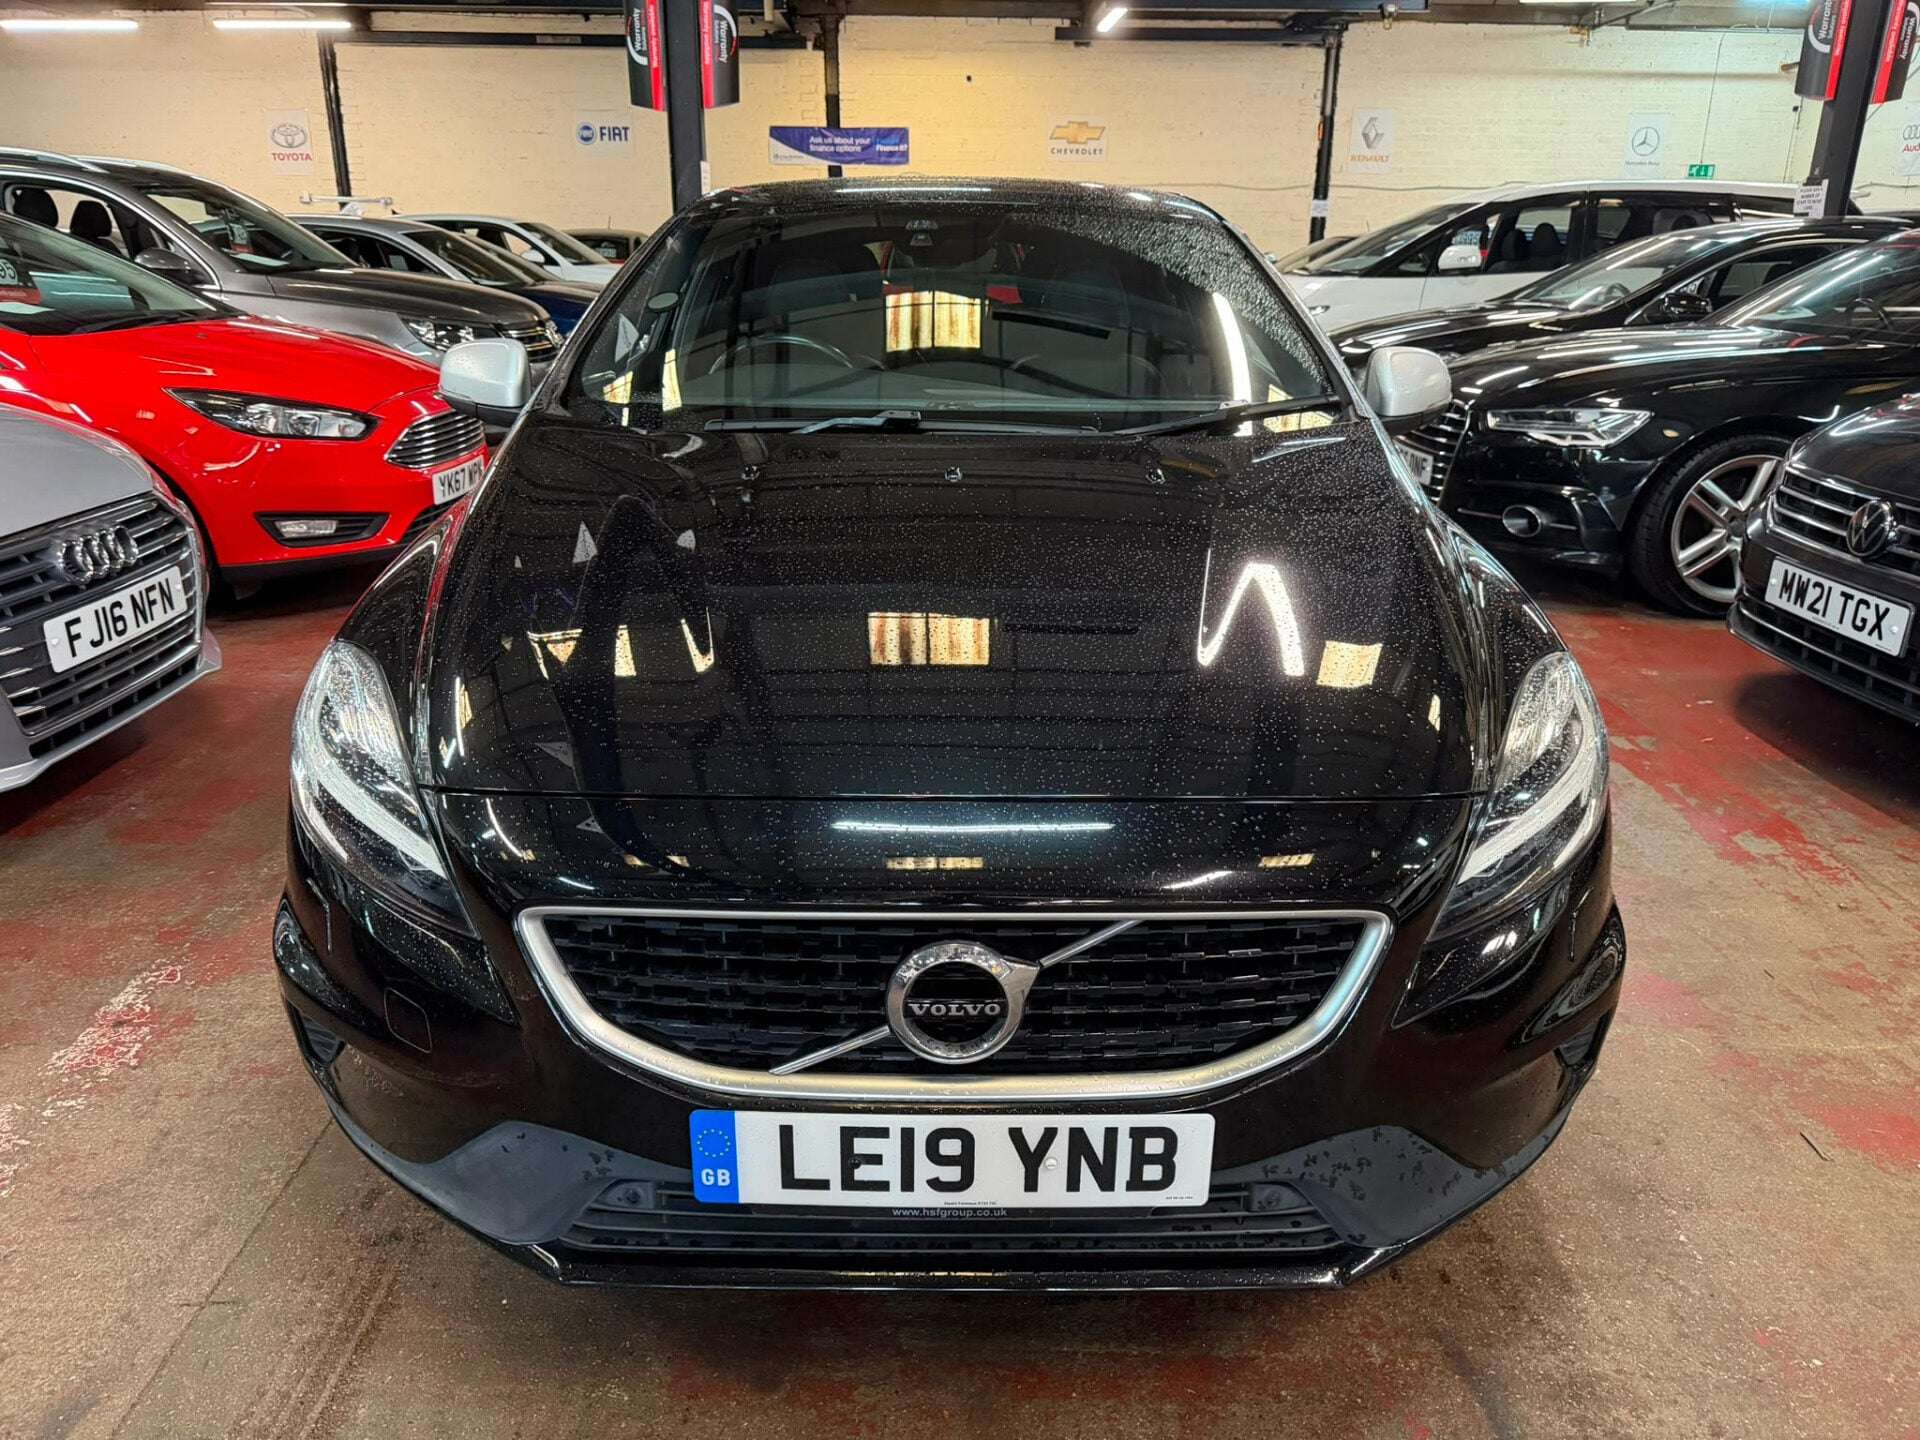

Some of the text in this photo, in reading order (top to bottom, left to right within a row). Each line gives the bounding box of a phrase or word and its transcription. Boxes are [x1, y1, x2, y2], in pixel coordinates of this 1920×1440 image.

[633, 8, 642, 51] Warranty
[1818, 0, 1832, 39] Warrant
[719, 20, 728, 63] Warranty
[1899, 17, 1915, 59] Warranty
[599, 126, 630, 141] FIAT
[809, 136, 823, 145] Ask
[855, 138, 871, 147] your
[272, 153, 312, 161] TOYOTA
[1050, 148, 1104, 156] CHEVROLET
[1903, 144, 1920, 152] Aud
[439, 467, 466, 498] YK67
[1779, 568, 1890, 641] MW21 TGX
[64, 578, 175, 657] FJ16 NFN
[908, 1003, 1000, 1016] VOLVO
[779, 1124, 1178, 1193] LE19 YNB
[701, 1168, 730, 1186] GB
[892, 1207, 1007, 1218] www.hsfgroup.co.uk
